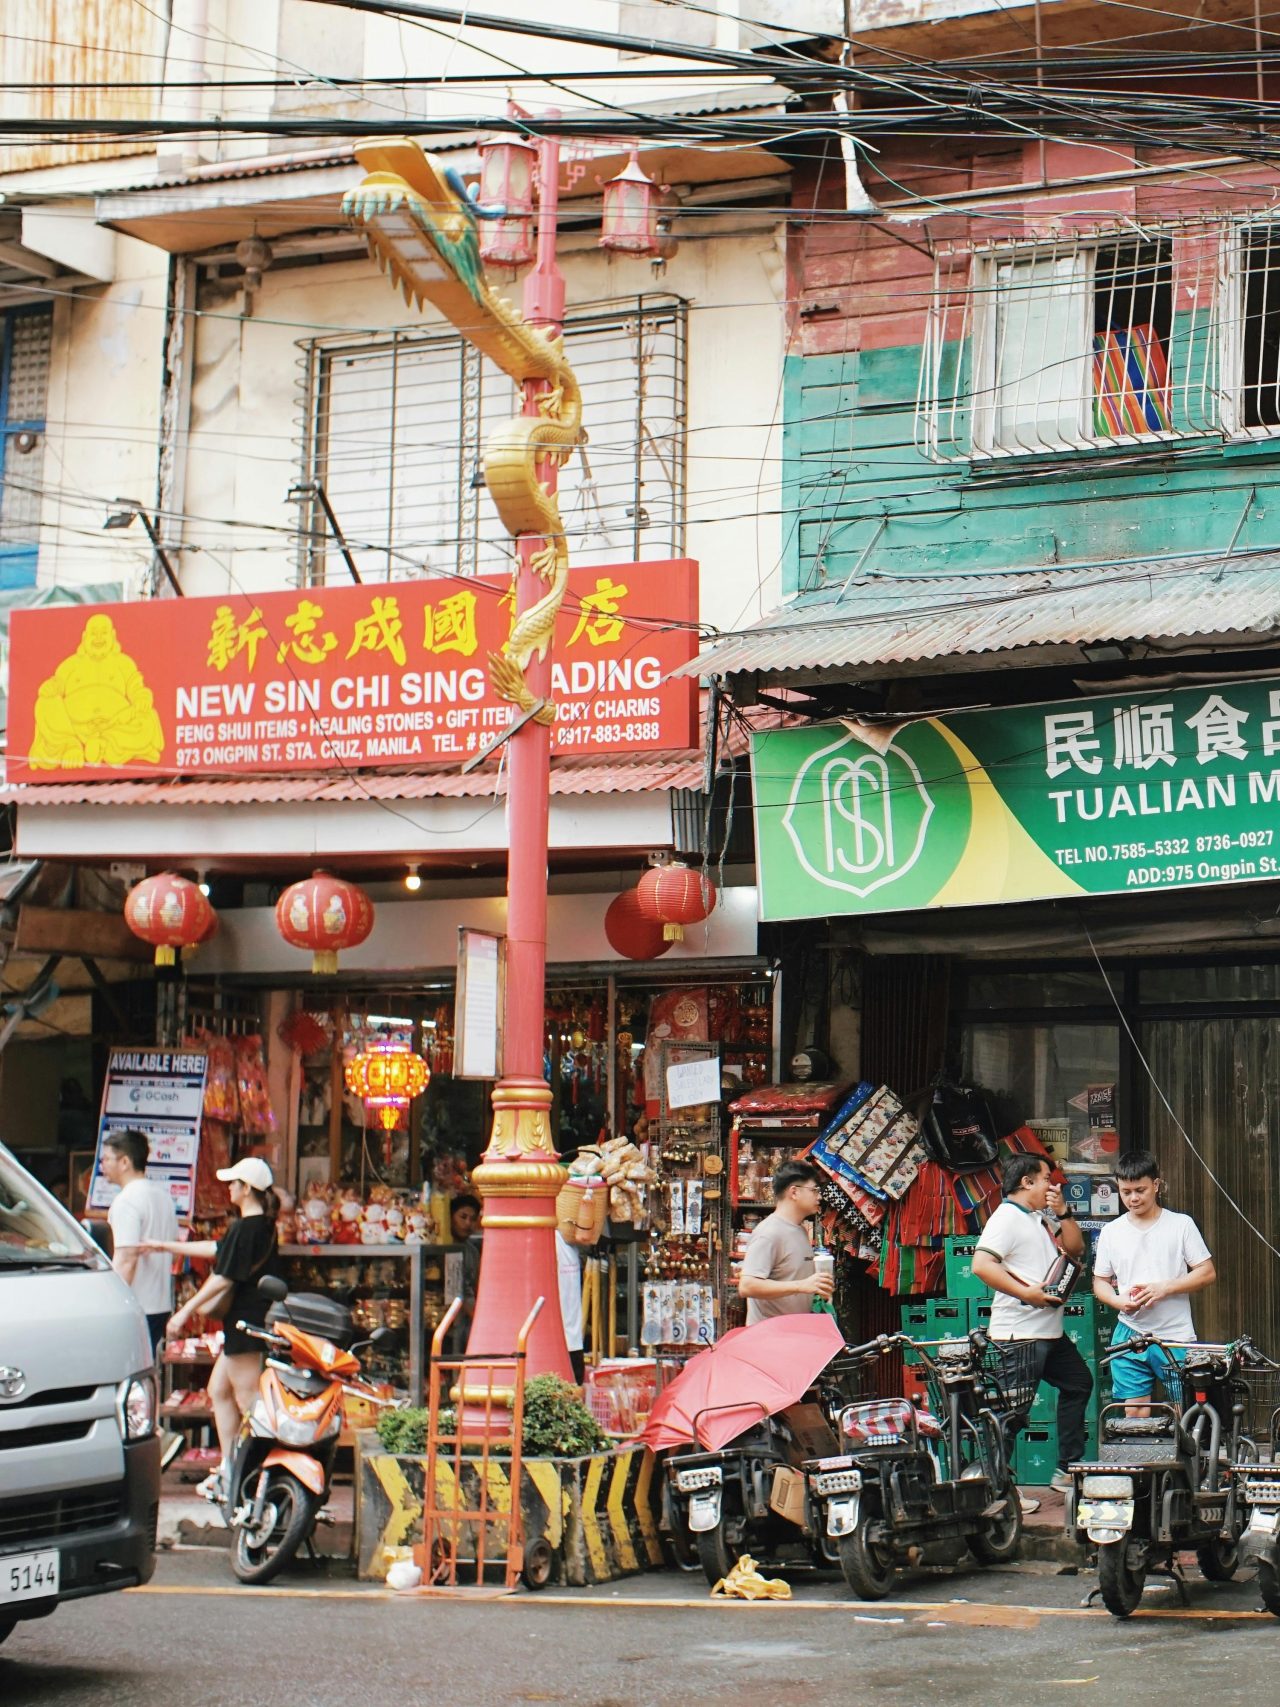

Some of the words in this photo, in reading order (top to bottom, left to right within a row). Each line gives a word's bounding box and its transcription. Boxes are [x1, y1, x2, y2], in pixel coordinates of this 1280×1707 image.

[206, 577, 628, 673] 新志成國店
[176, 683, 255, 719] NEW
[264, 679, 321, 714] SIN
[330, 675, 390, 710] CHI
[400, 669, 485, 705] SING
[552, 656, 661, 695] ADING
[176, 724, 214, 744] FENG
[218, 722, 251, 742] SHUI
[254, 719, 297, 740] ITEMS
[310, 715, 372, 737] HEALING
[376, 711, 433, 733] STONES
[446, 709, 479, 728] GIFT
[482, 707, 514, 726] ITEM
[554, 701, 590, 722] CKY
[595, 697, 660, 719] CHARMS
[176, 748, 200, 767] 973
[203, 745, 258, 765] ONGPIN
[261, 743, 282, 761] ST.
[285, 741, 316, 760] STA.
[320, 739, 363, 760] CRUZ,
[366, 736, 422, 757] MANILA
[432, 734, 463, 753] TEL.
[558, 722, 659, 747] 0917-883-8388
[1048, 774, 1236, 824] TUALIAN
[1055, 849, 1082, 866] TEL
[1085, 838, 1189, 863] NO.7585-5332
[1196, 830, 1274, 853] 8736-0927
[1126, 864, 1194, 886] ADD:975
[1197, 859, 1255, 880] Ongpin
[110, 1053, 170, 1072] AVAILABLE
[172, 1055, 205, 1073] HERE!
[11, 1561, 55, 1592] 5144
